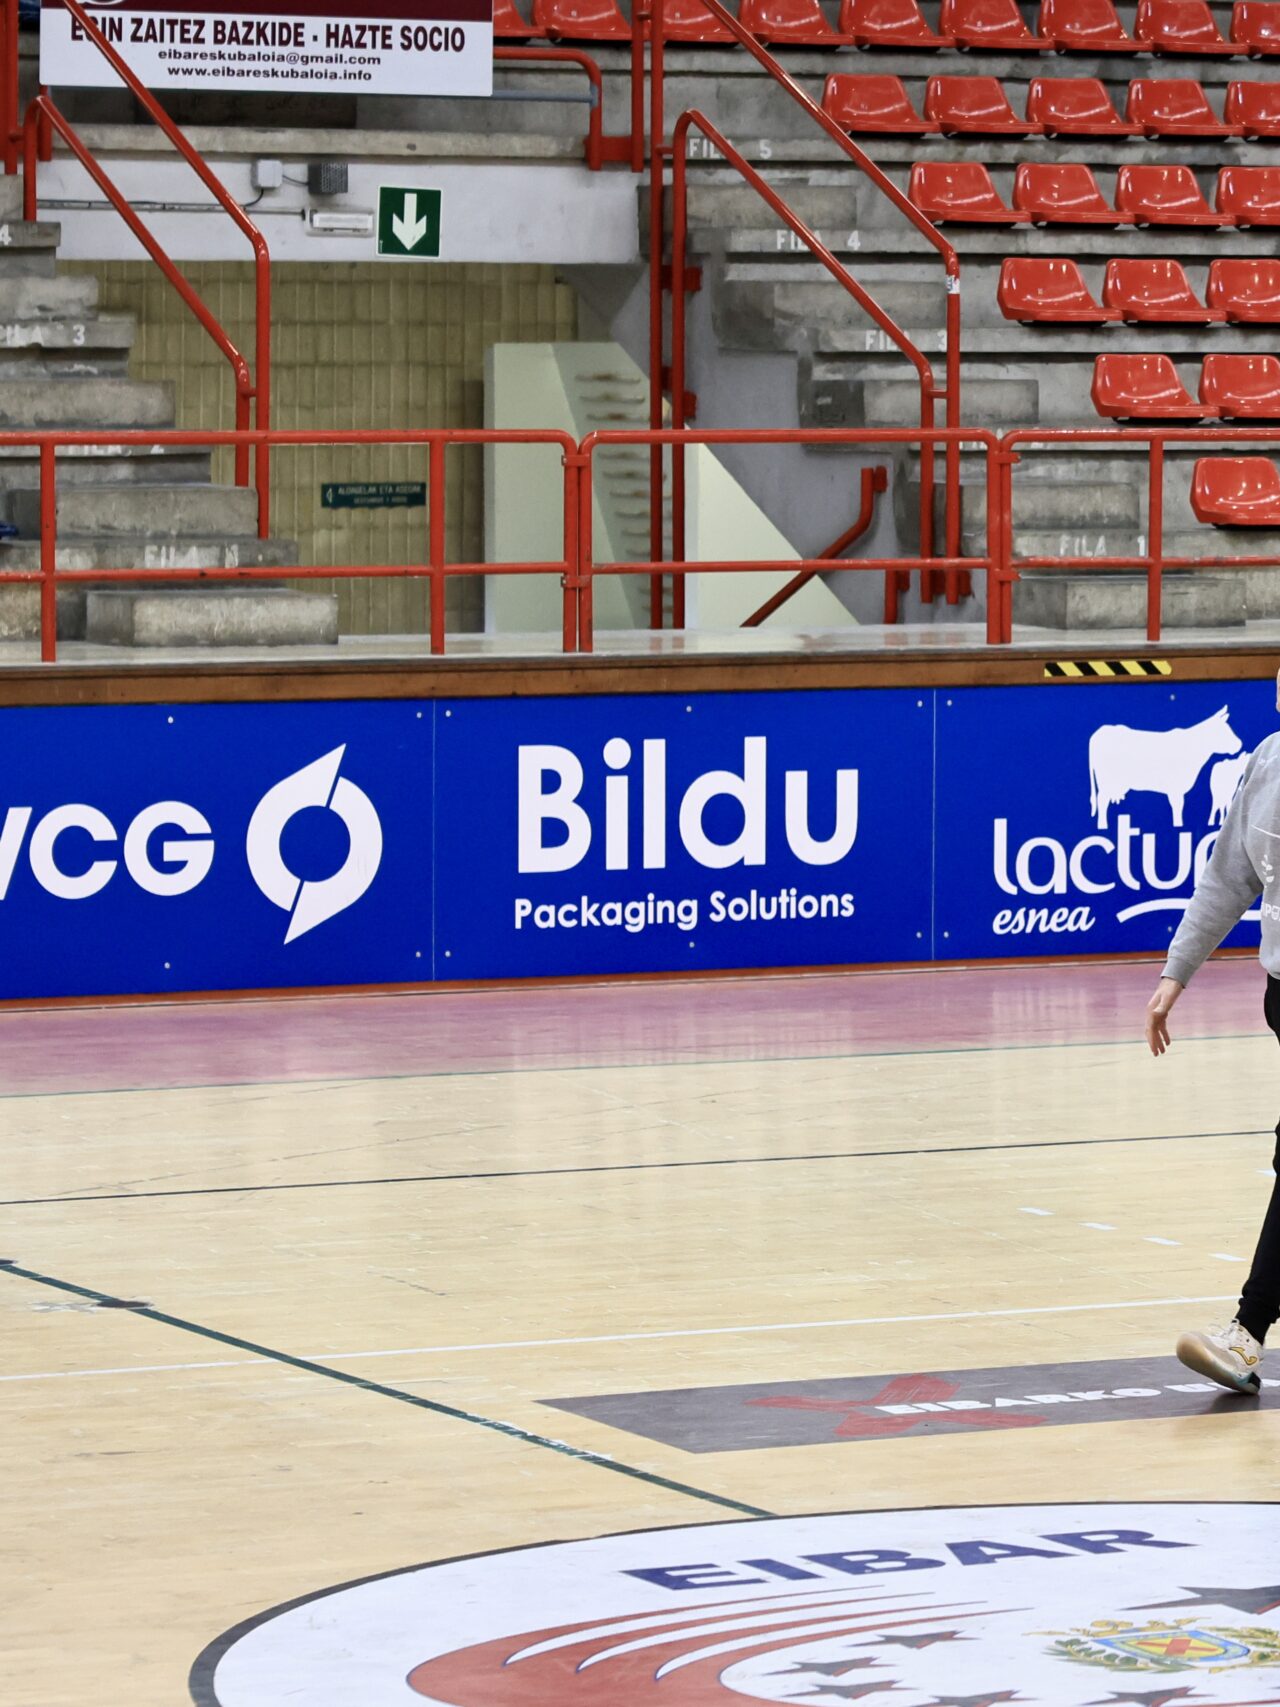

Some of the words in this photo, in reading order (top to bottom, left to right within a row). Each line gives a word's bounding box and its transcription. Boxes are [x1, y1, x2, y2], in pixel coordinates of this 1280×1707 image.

[130, 17, 206, 45] ZAITEZ
[213, 20, 305, 47] BAZKIDE
[325, 23, 393, 49] HAZTE
[400, 26, 465, 52] SOCIO
[158, 49, 381, 66] eibareskubaloia@gmail.com
[168, 66, 372, 81] www.eibareskubaloia.info
[689, 137, 735, 160] FIL
[759, 138, 772, 160] 5
[847, 230, 861, 251] 4
[73, 324, 86, 346] 3
[1059, 534, 1107, 557] FILA
[1137, 534, 1147, 557] 1
[518, 735, 859, 874] Bildu
[515, 893, 698, 933] Packaging
[709, 887, 855, 922] Solutions
[992, 906, 1096, 936] esnea
[874, 1388, 1162, 1415] EIBARKO
[618, 1529, 1200, 1591] EIBAR
